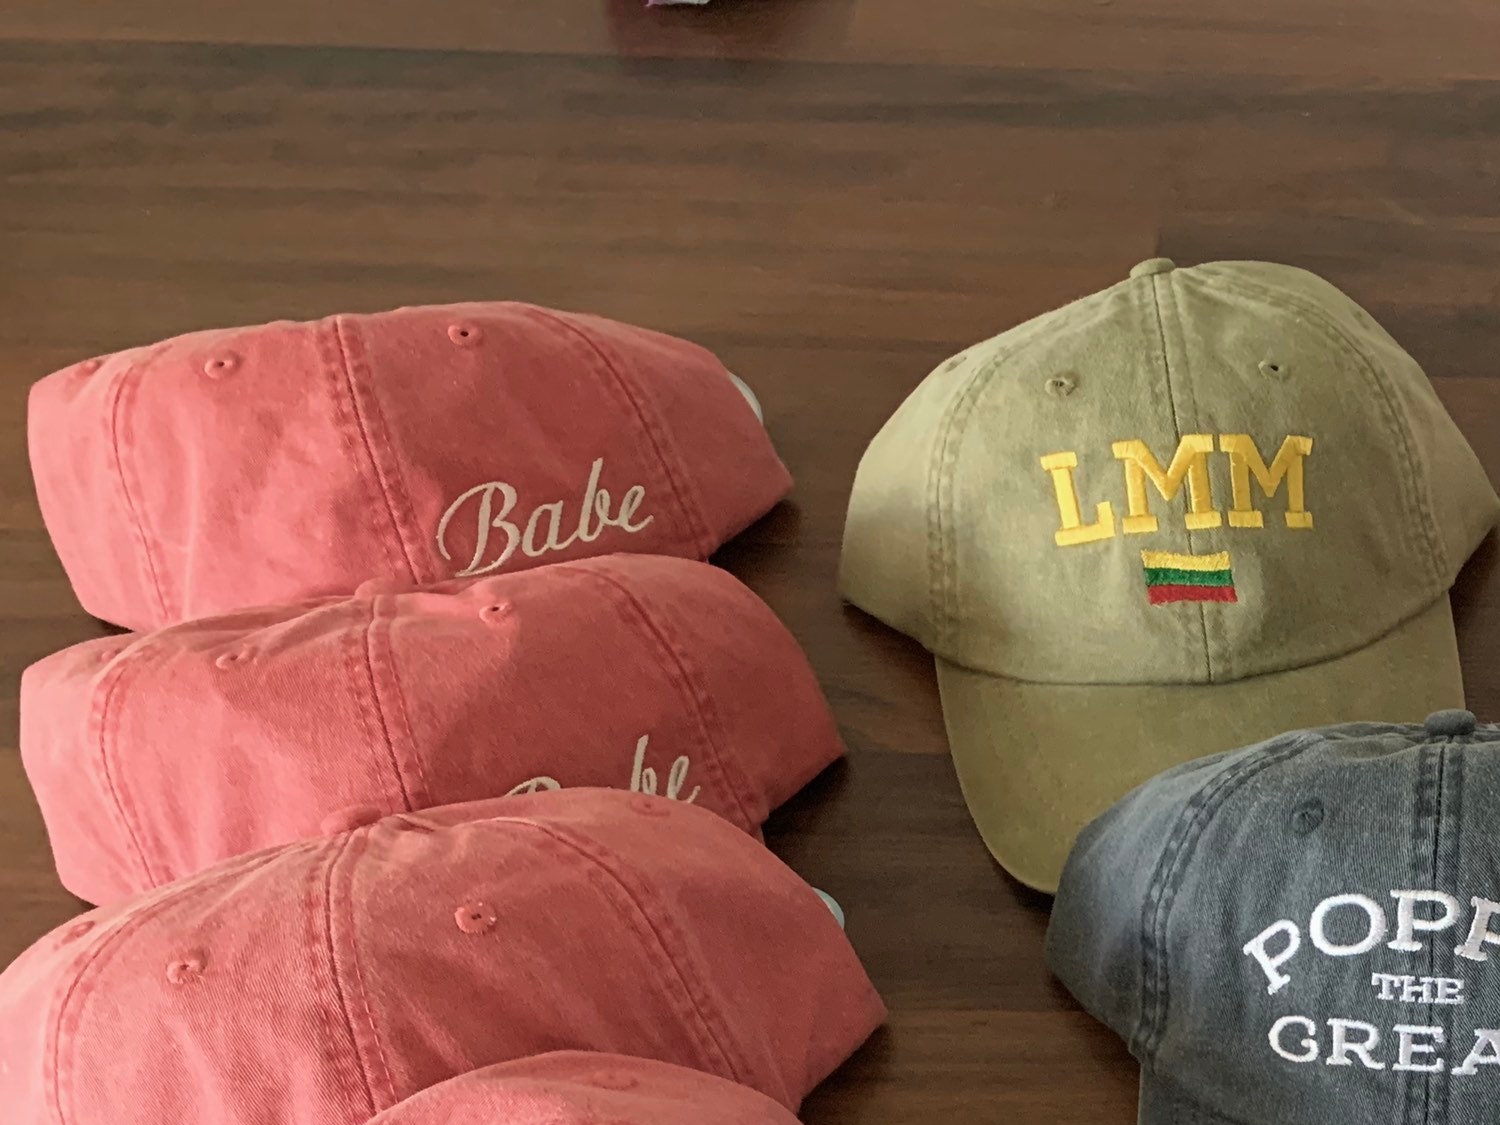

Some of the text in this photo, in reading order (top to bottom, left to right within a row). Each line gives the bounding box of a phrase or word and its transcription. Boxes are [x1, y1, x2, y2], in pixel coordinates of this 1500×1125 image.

[436, 458, 653, 577] Babe
[1040, 434, 1314, 547] LMM
[1372, 972, 1465, 1005] THE
